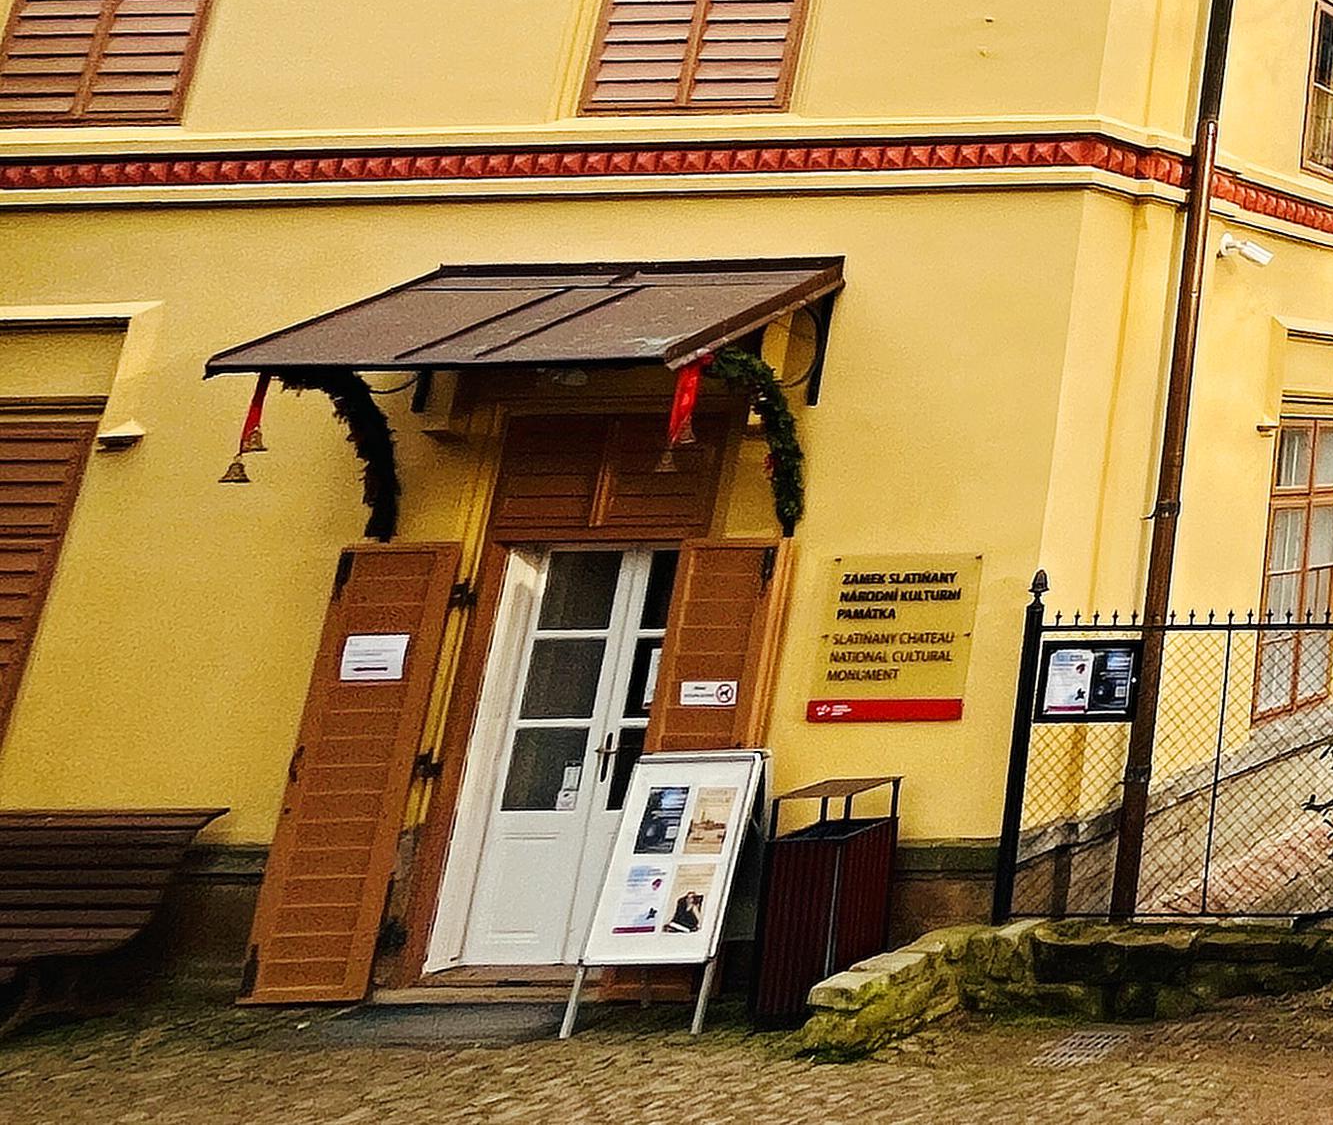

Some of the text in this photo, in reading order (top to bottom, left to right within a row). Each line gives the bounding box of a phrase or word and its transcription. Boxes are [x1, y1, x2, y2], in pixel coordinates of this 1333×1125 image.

[900, 587, 962, 601] KULTURNÍ
[829, 650, 953, 663] NATIONAL CULTURAL
[826, 668, 900, 682] MONUMENT
